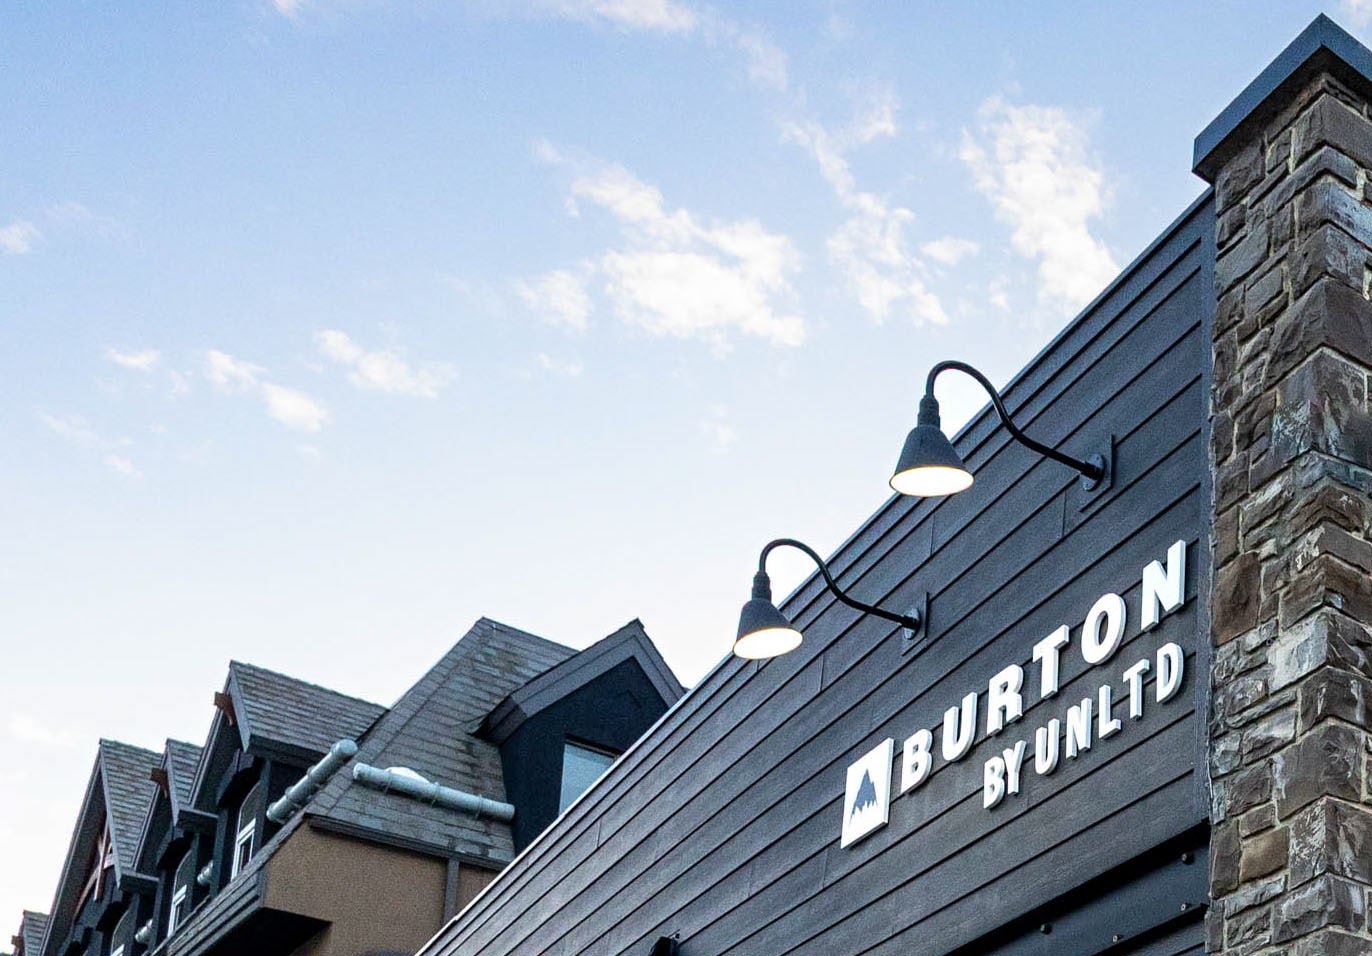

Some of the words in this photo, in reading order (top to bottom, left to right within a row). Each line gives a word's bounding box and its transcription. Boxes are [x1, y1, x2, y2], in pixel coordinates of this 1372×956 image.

[900, 539, 1186, 795] BURTON
[983, 740, 1026, 810] BY
[1035, 642, 1184, 775] UNLTD
